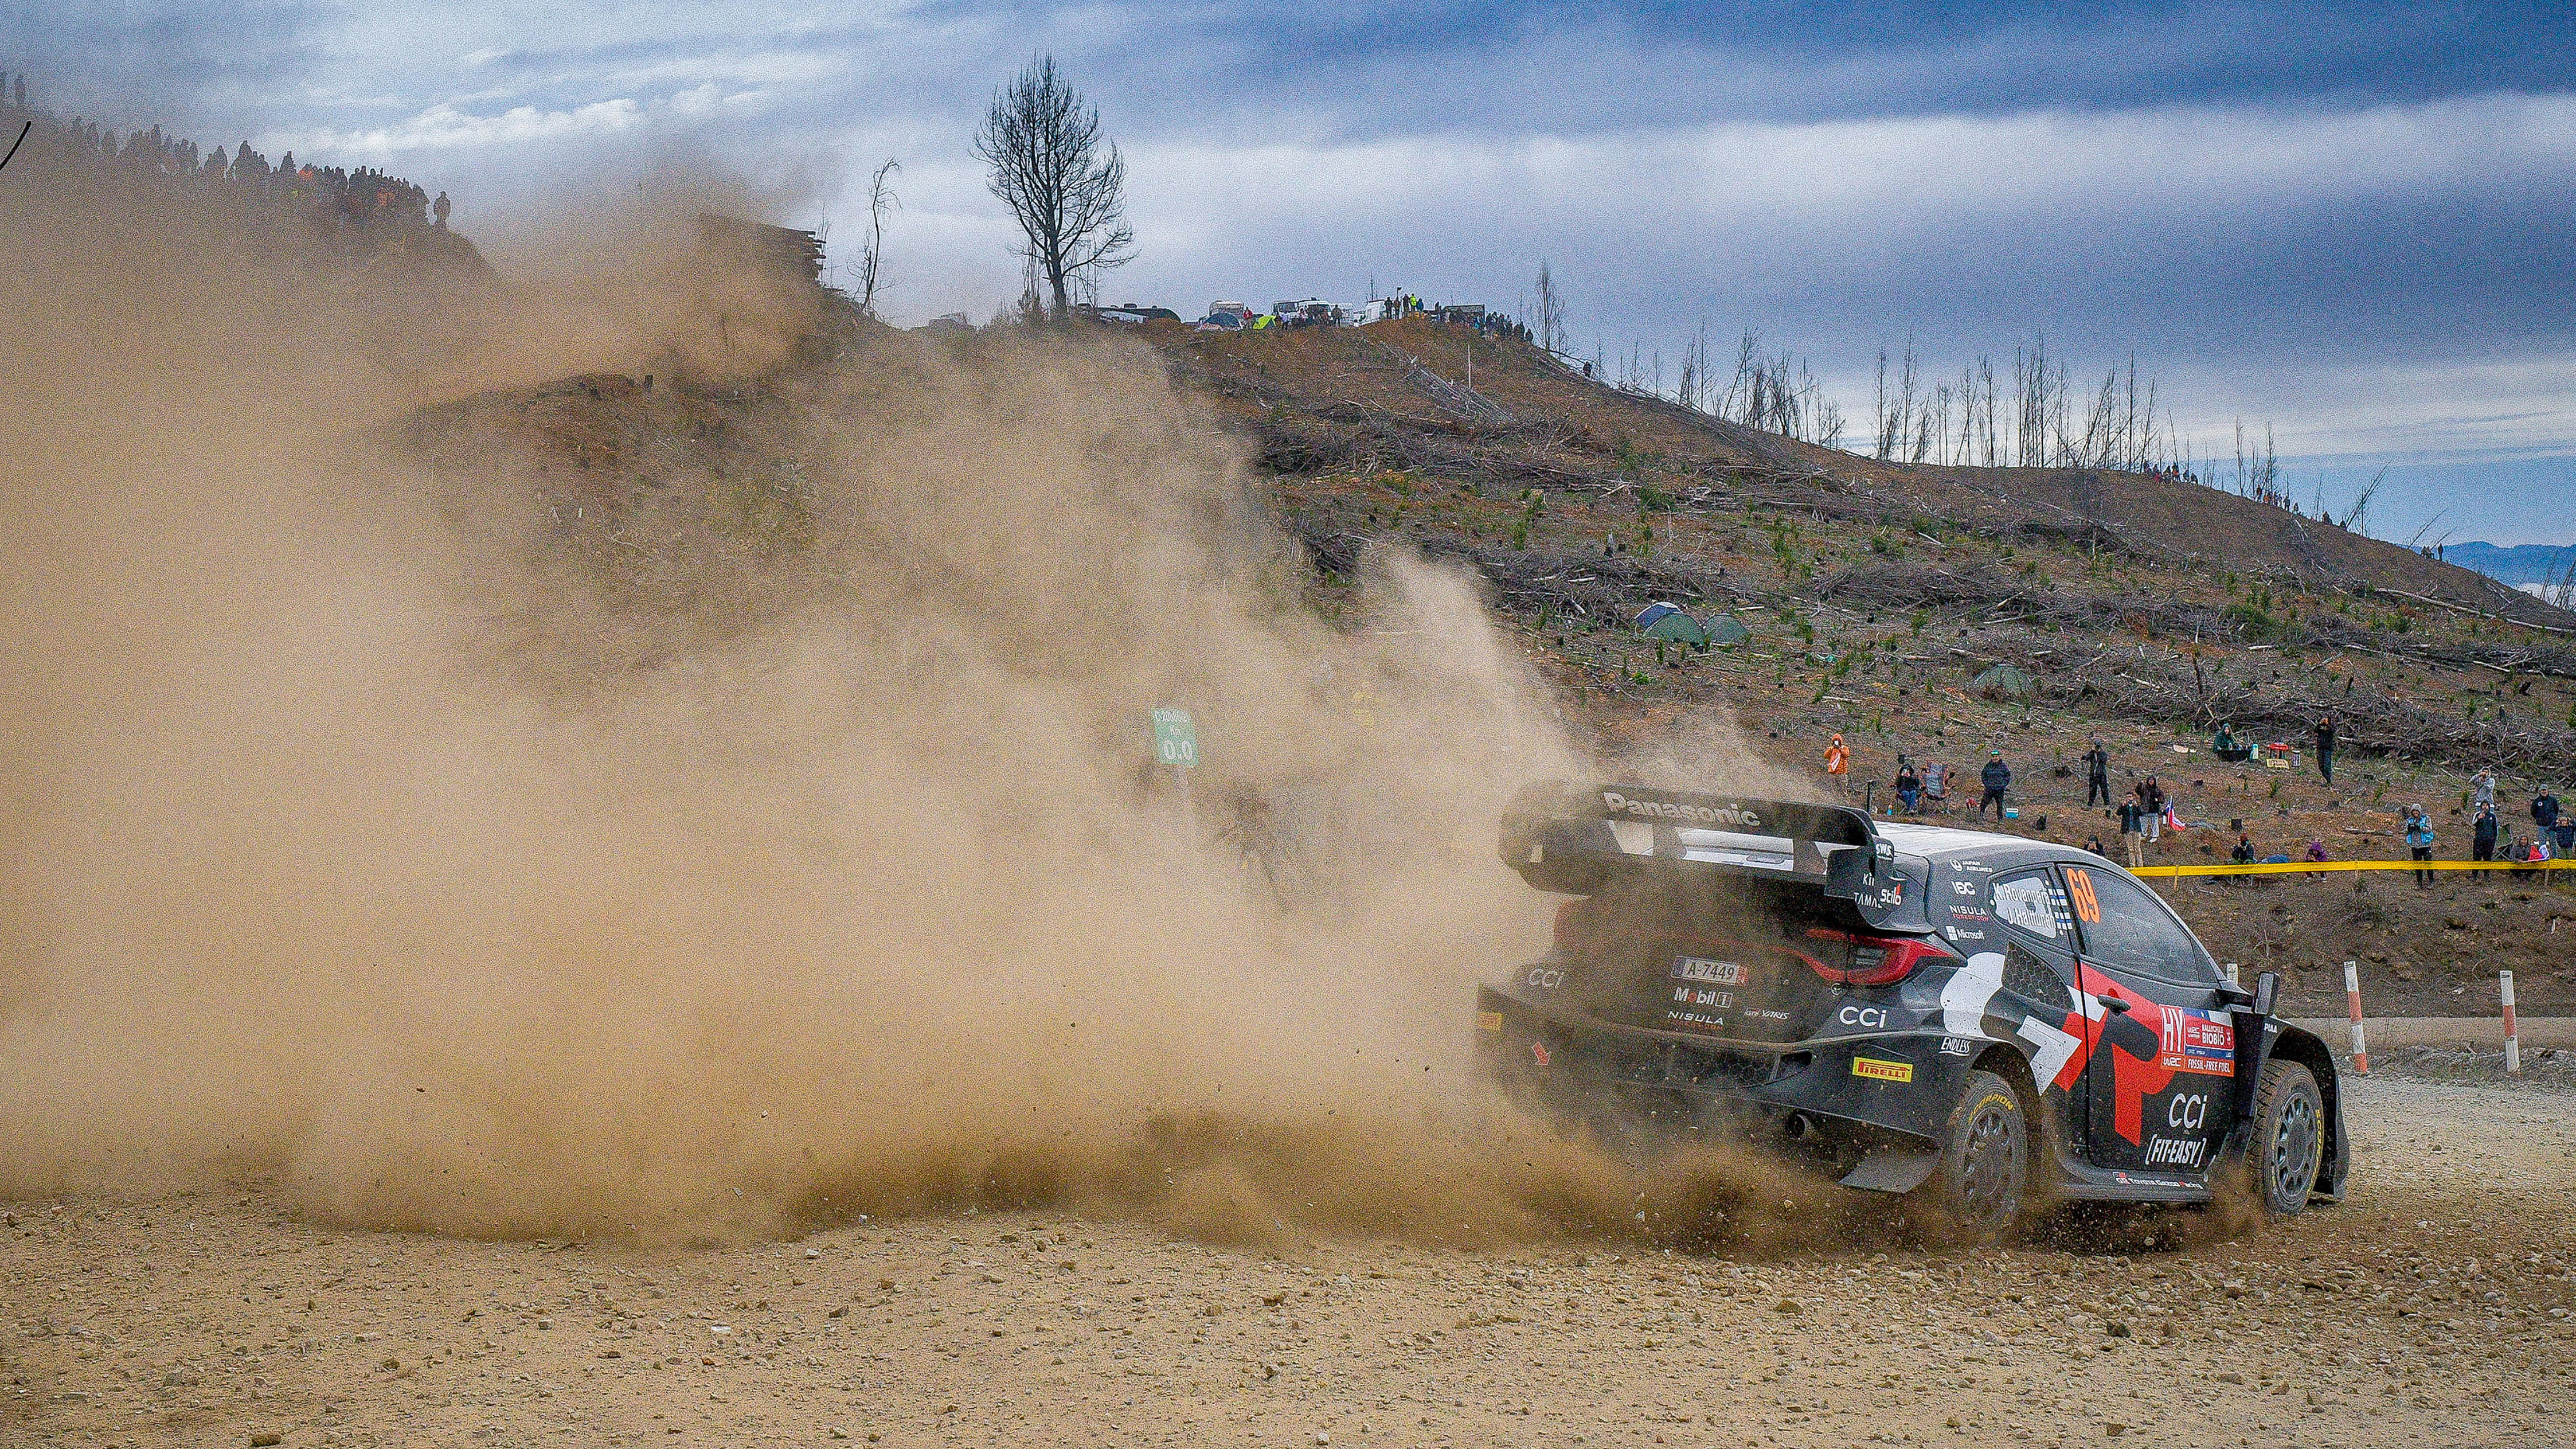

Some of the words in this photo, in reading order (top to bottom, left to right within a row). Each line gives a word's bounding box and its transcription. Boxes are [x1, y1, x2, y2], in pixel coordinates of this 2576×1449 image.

[1170, 725, 1181, 736] Km
[1163, 740, 1194, 760] 0.0
[1603, 791, 1761, 826] Panasonic
[1875, 843, 1893, 857] SWS
[1853, 892, 1883, 909] TAMA
[1880, 884, 1902, 905] Stilo
[2066, 868, 2101, 924] 69
[1949, 905, 1987, 916] NISULA
[1957, 929, 1985, 940] Microsoft
[1528, 968, 1565, 990] CCi
[1686, 962, 1735, 981] A-7449
[1673, 986, 1717, 1006] Mobil
[1667, 1011, 1724, 1025] NISULA
[1762, 1010, 1790, 1020] YARIS
[1838, 1006, 1887, 1029] CCi
[2160, 1007, 2183, 1053] HY
[2264, 1022, 2278, 1034] PIAA
[1941, 1036, 1971, 1053] ENDLESS
[1858, 1061, 1910, 1078] PIRELLI
[2163, 1056, 2182, 1068] WRC
[2187, 1058, 2218, 1071] FOSSIL-FREE
[2218, 1061, 2231, 1073] FUEL
[2168, 1092, 2208, 1129] CCi
